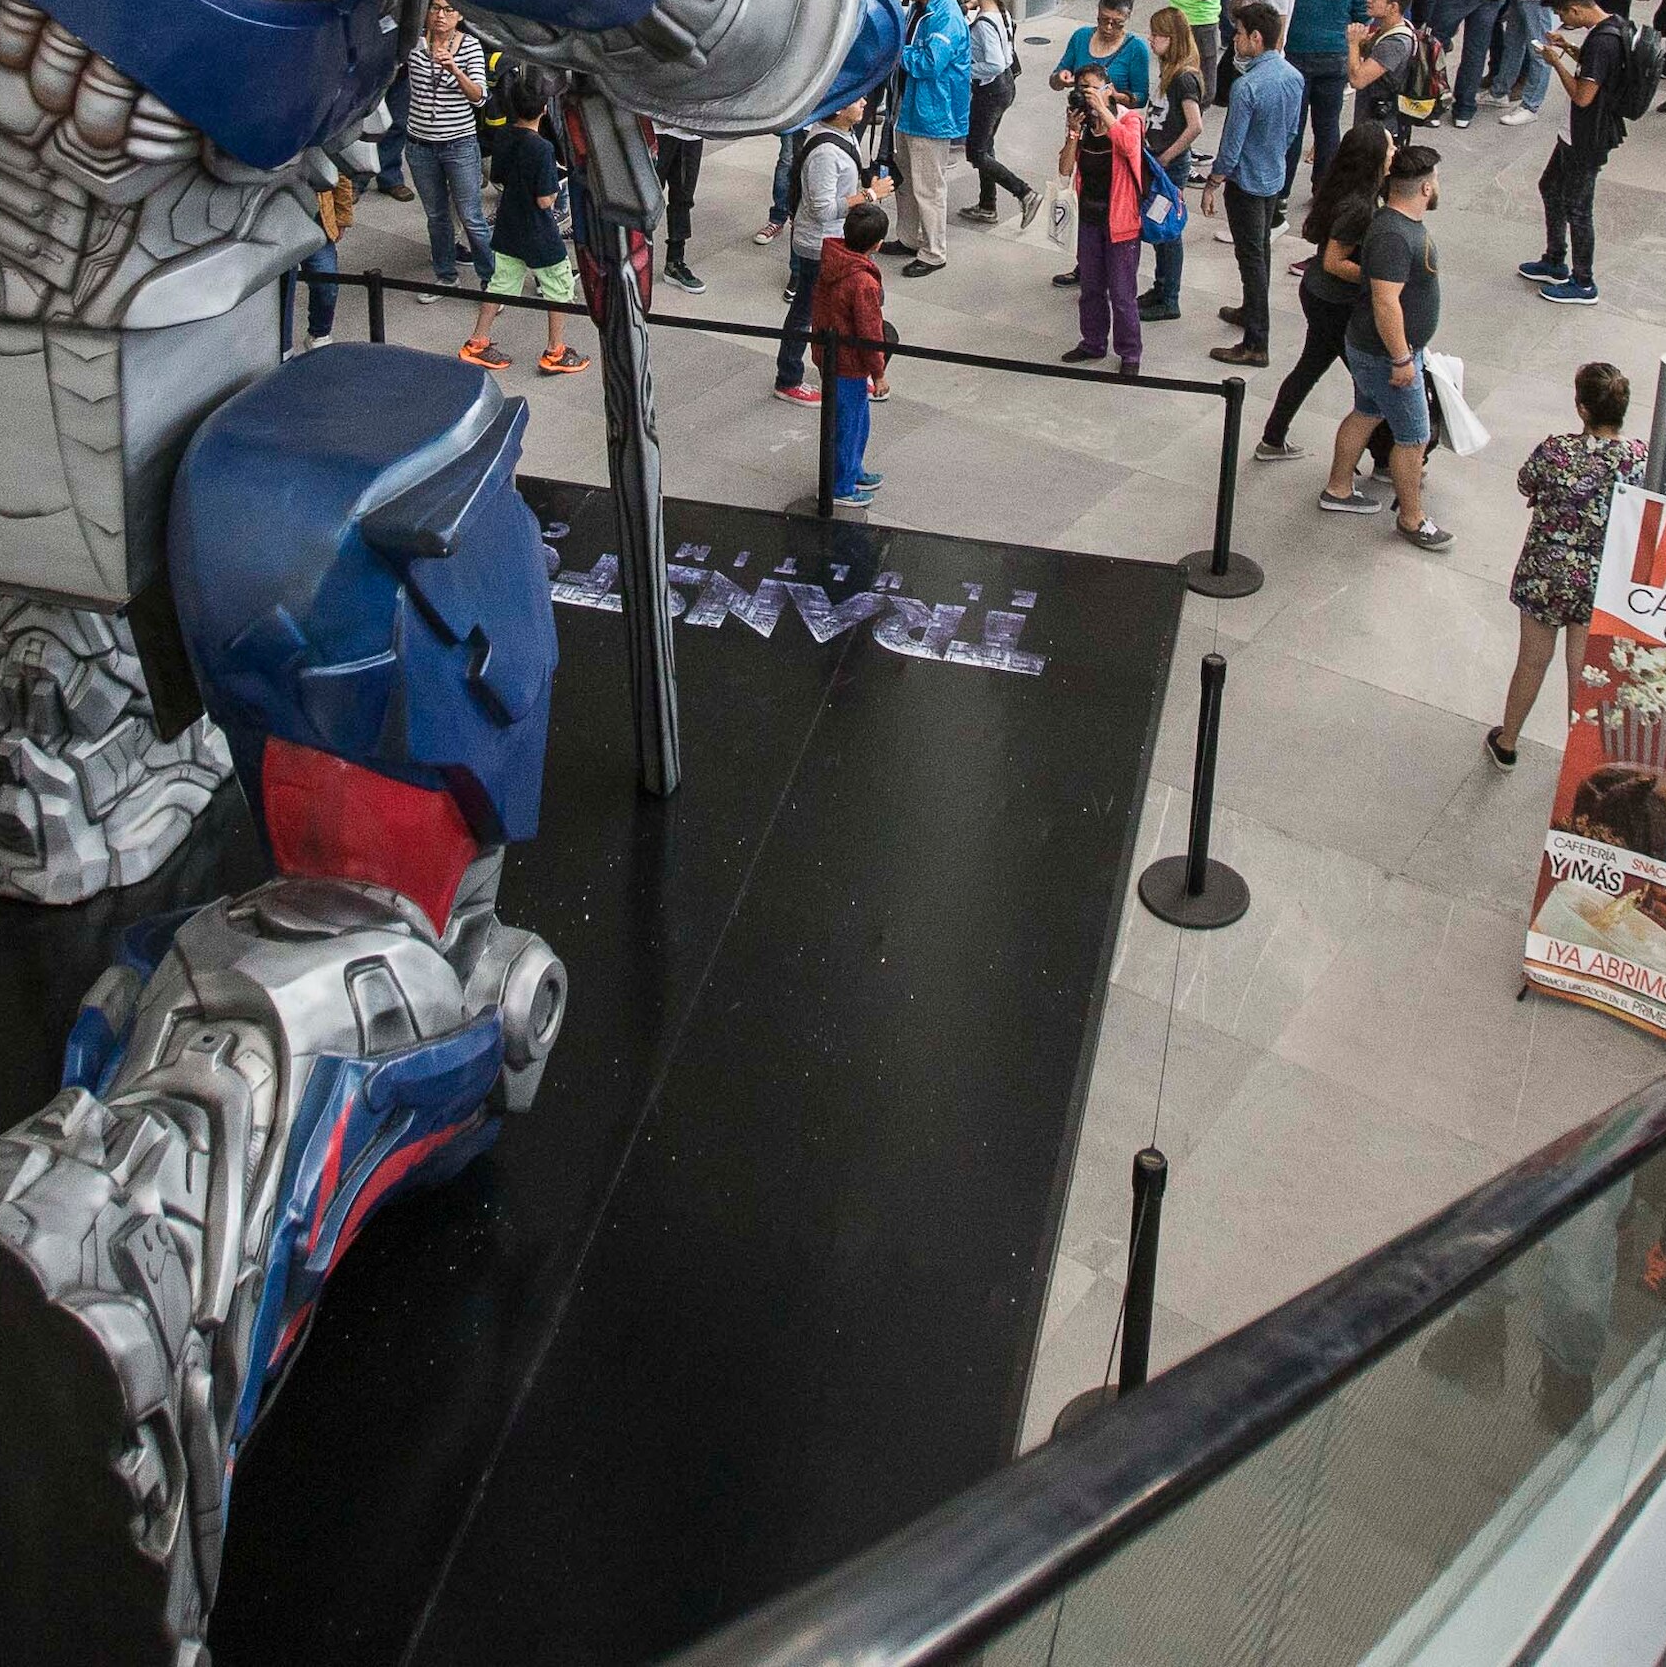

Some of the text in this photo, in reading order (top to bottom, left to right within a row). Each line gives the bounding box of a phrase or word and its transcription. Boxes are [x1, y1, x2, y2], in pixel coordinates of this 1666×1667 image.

[675, 540, 906, 592] ÚLTIM
[1554, 835, 1618, 864] CAFETERÍA
[1551, 854, 1622, 892] Y MÁS
[1547, 940, 1583, 970] ¡YA
